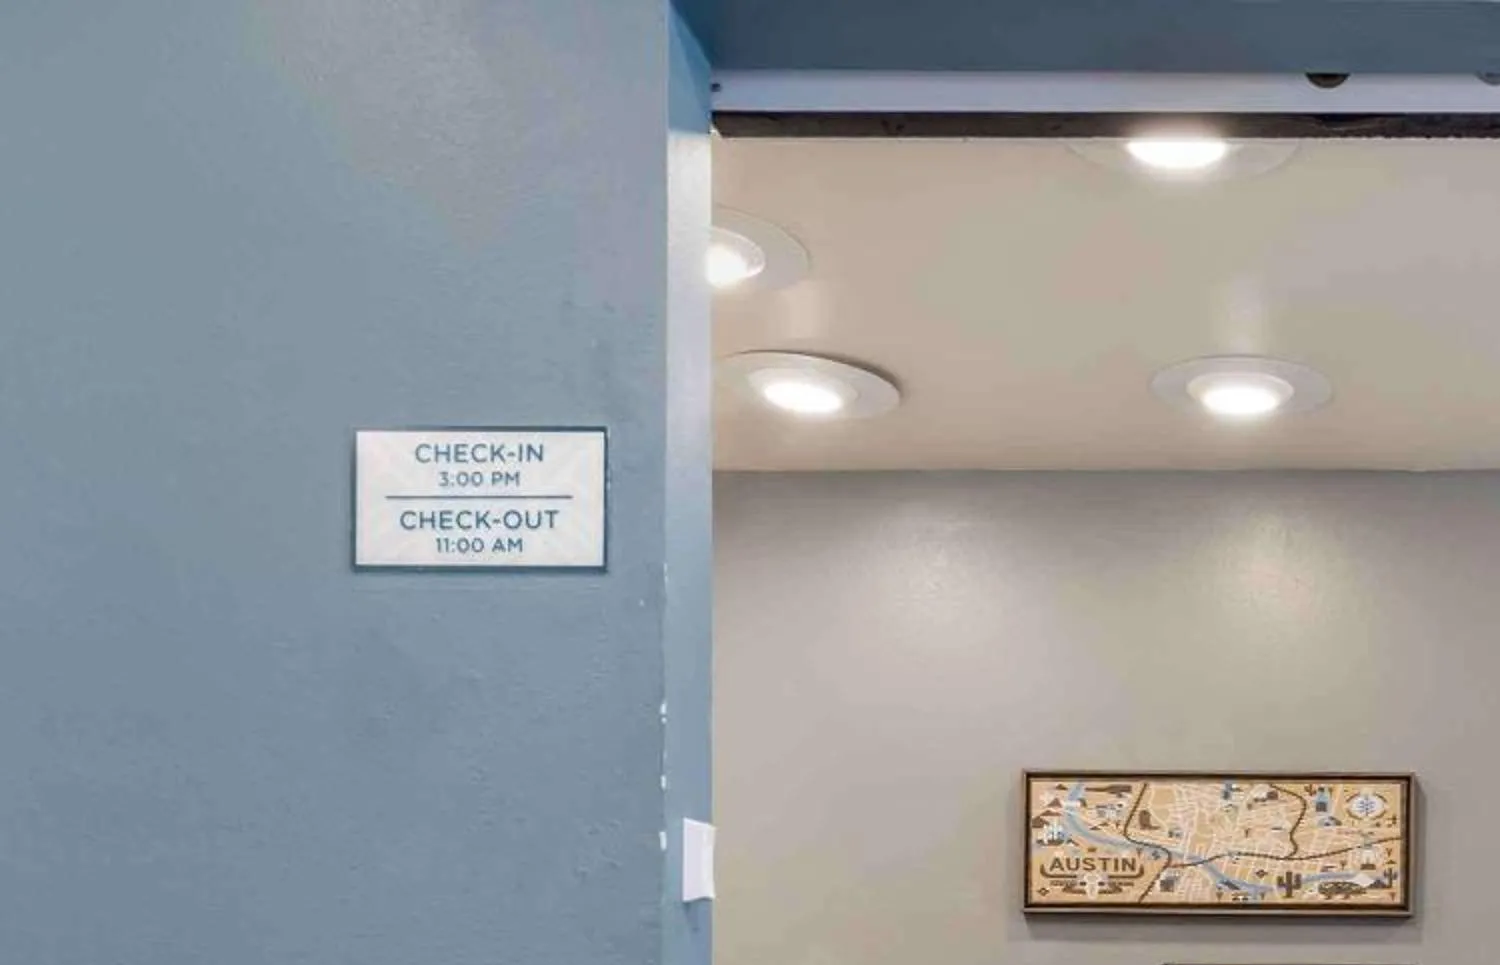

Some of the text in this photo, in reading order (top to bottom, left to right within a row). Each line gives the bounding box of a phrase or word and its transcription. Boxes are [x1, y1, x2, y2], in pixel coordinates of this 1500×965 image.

[414, 443, 545, 464] CHECK-IN
[438, 471, 521, 487] 3:00 PM
[399, 509, 560, 531] CHECK-OUT
[436, 537, 523, 554] 11:00 AM
[1049, 857, 1137, 872] AUSTIN
